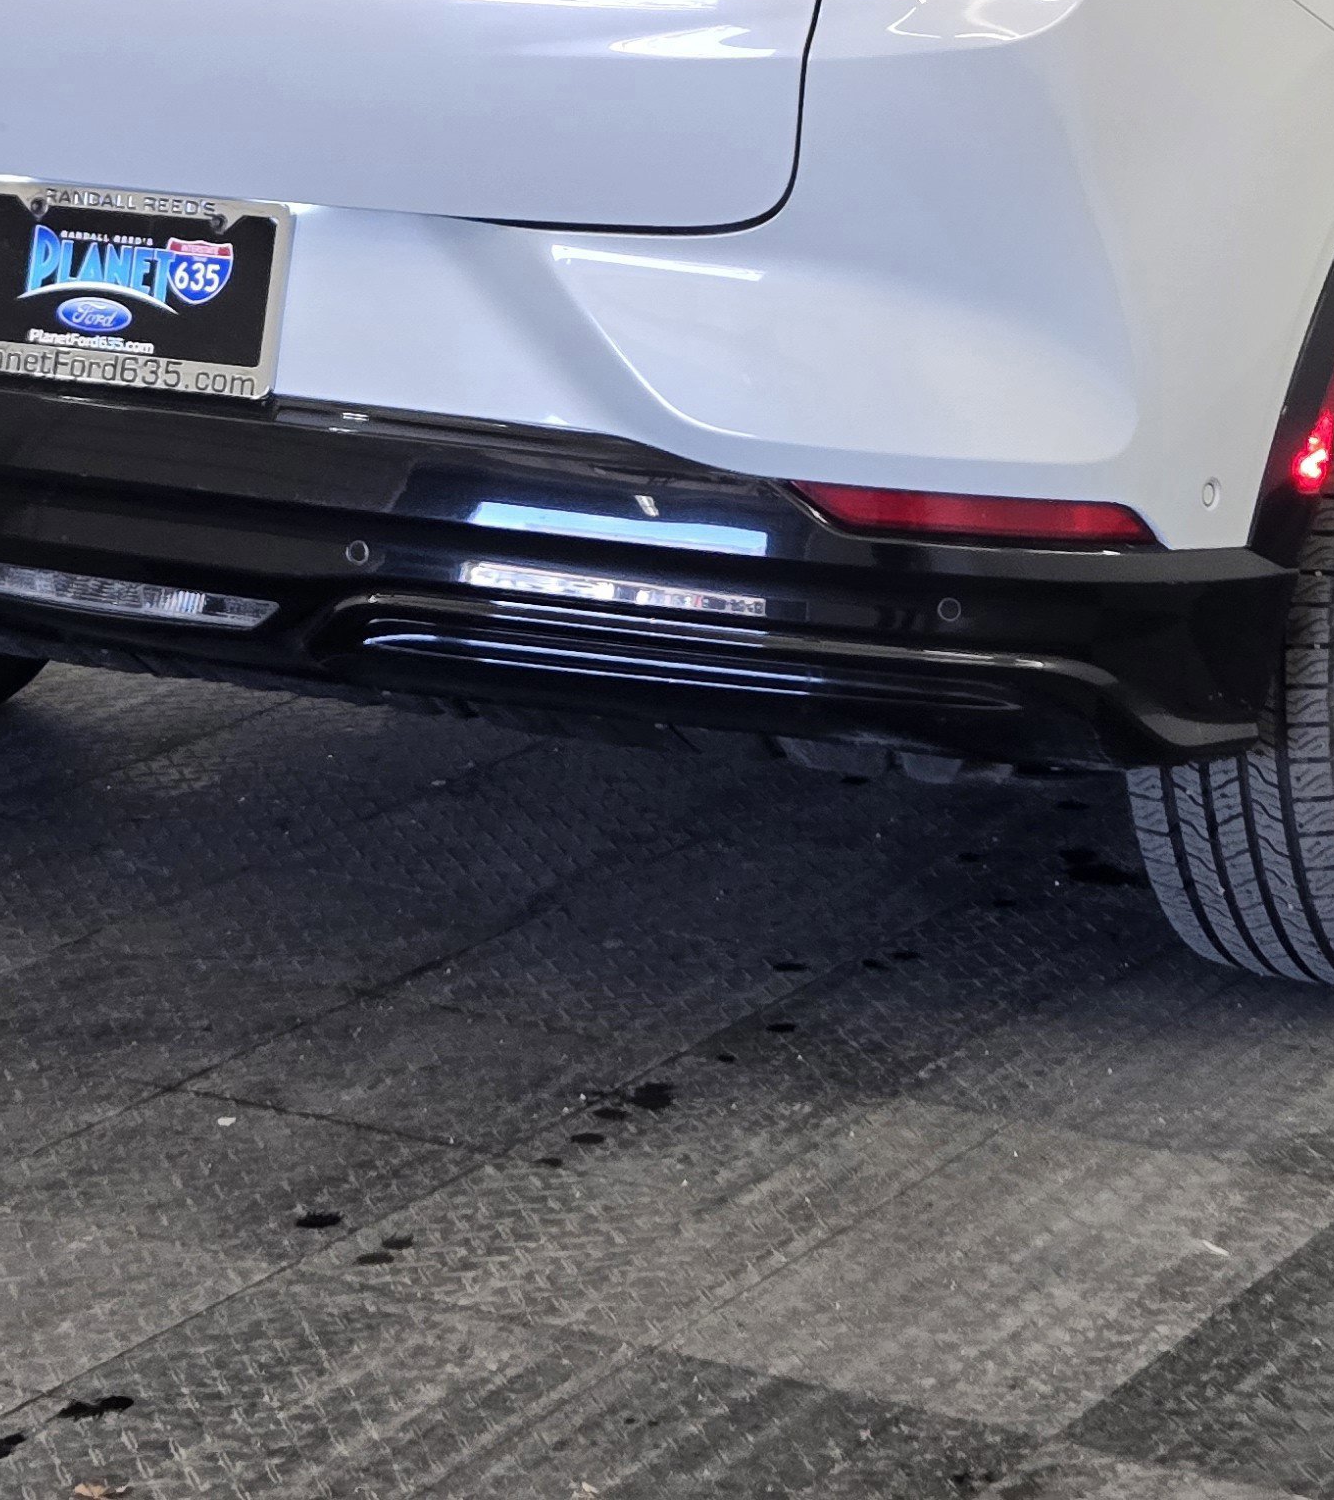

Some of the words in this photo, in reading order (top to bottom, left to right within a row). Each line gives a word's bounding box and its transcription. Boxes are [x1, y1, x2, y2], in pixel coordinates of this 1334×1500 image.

[45, 188, 137, 210] RANDALL
[144, 197, 216, 217] REED'S
[29, 225, 175, 303] PLANET
[174, 261, 220, 293] 635
[72, 302, 116, 328] Ford
[28, 328, 154, 354] PlanetFord635.com
